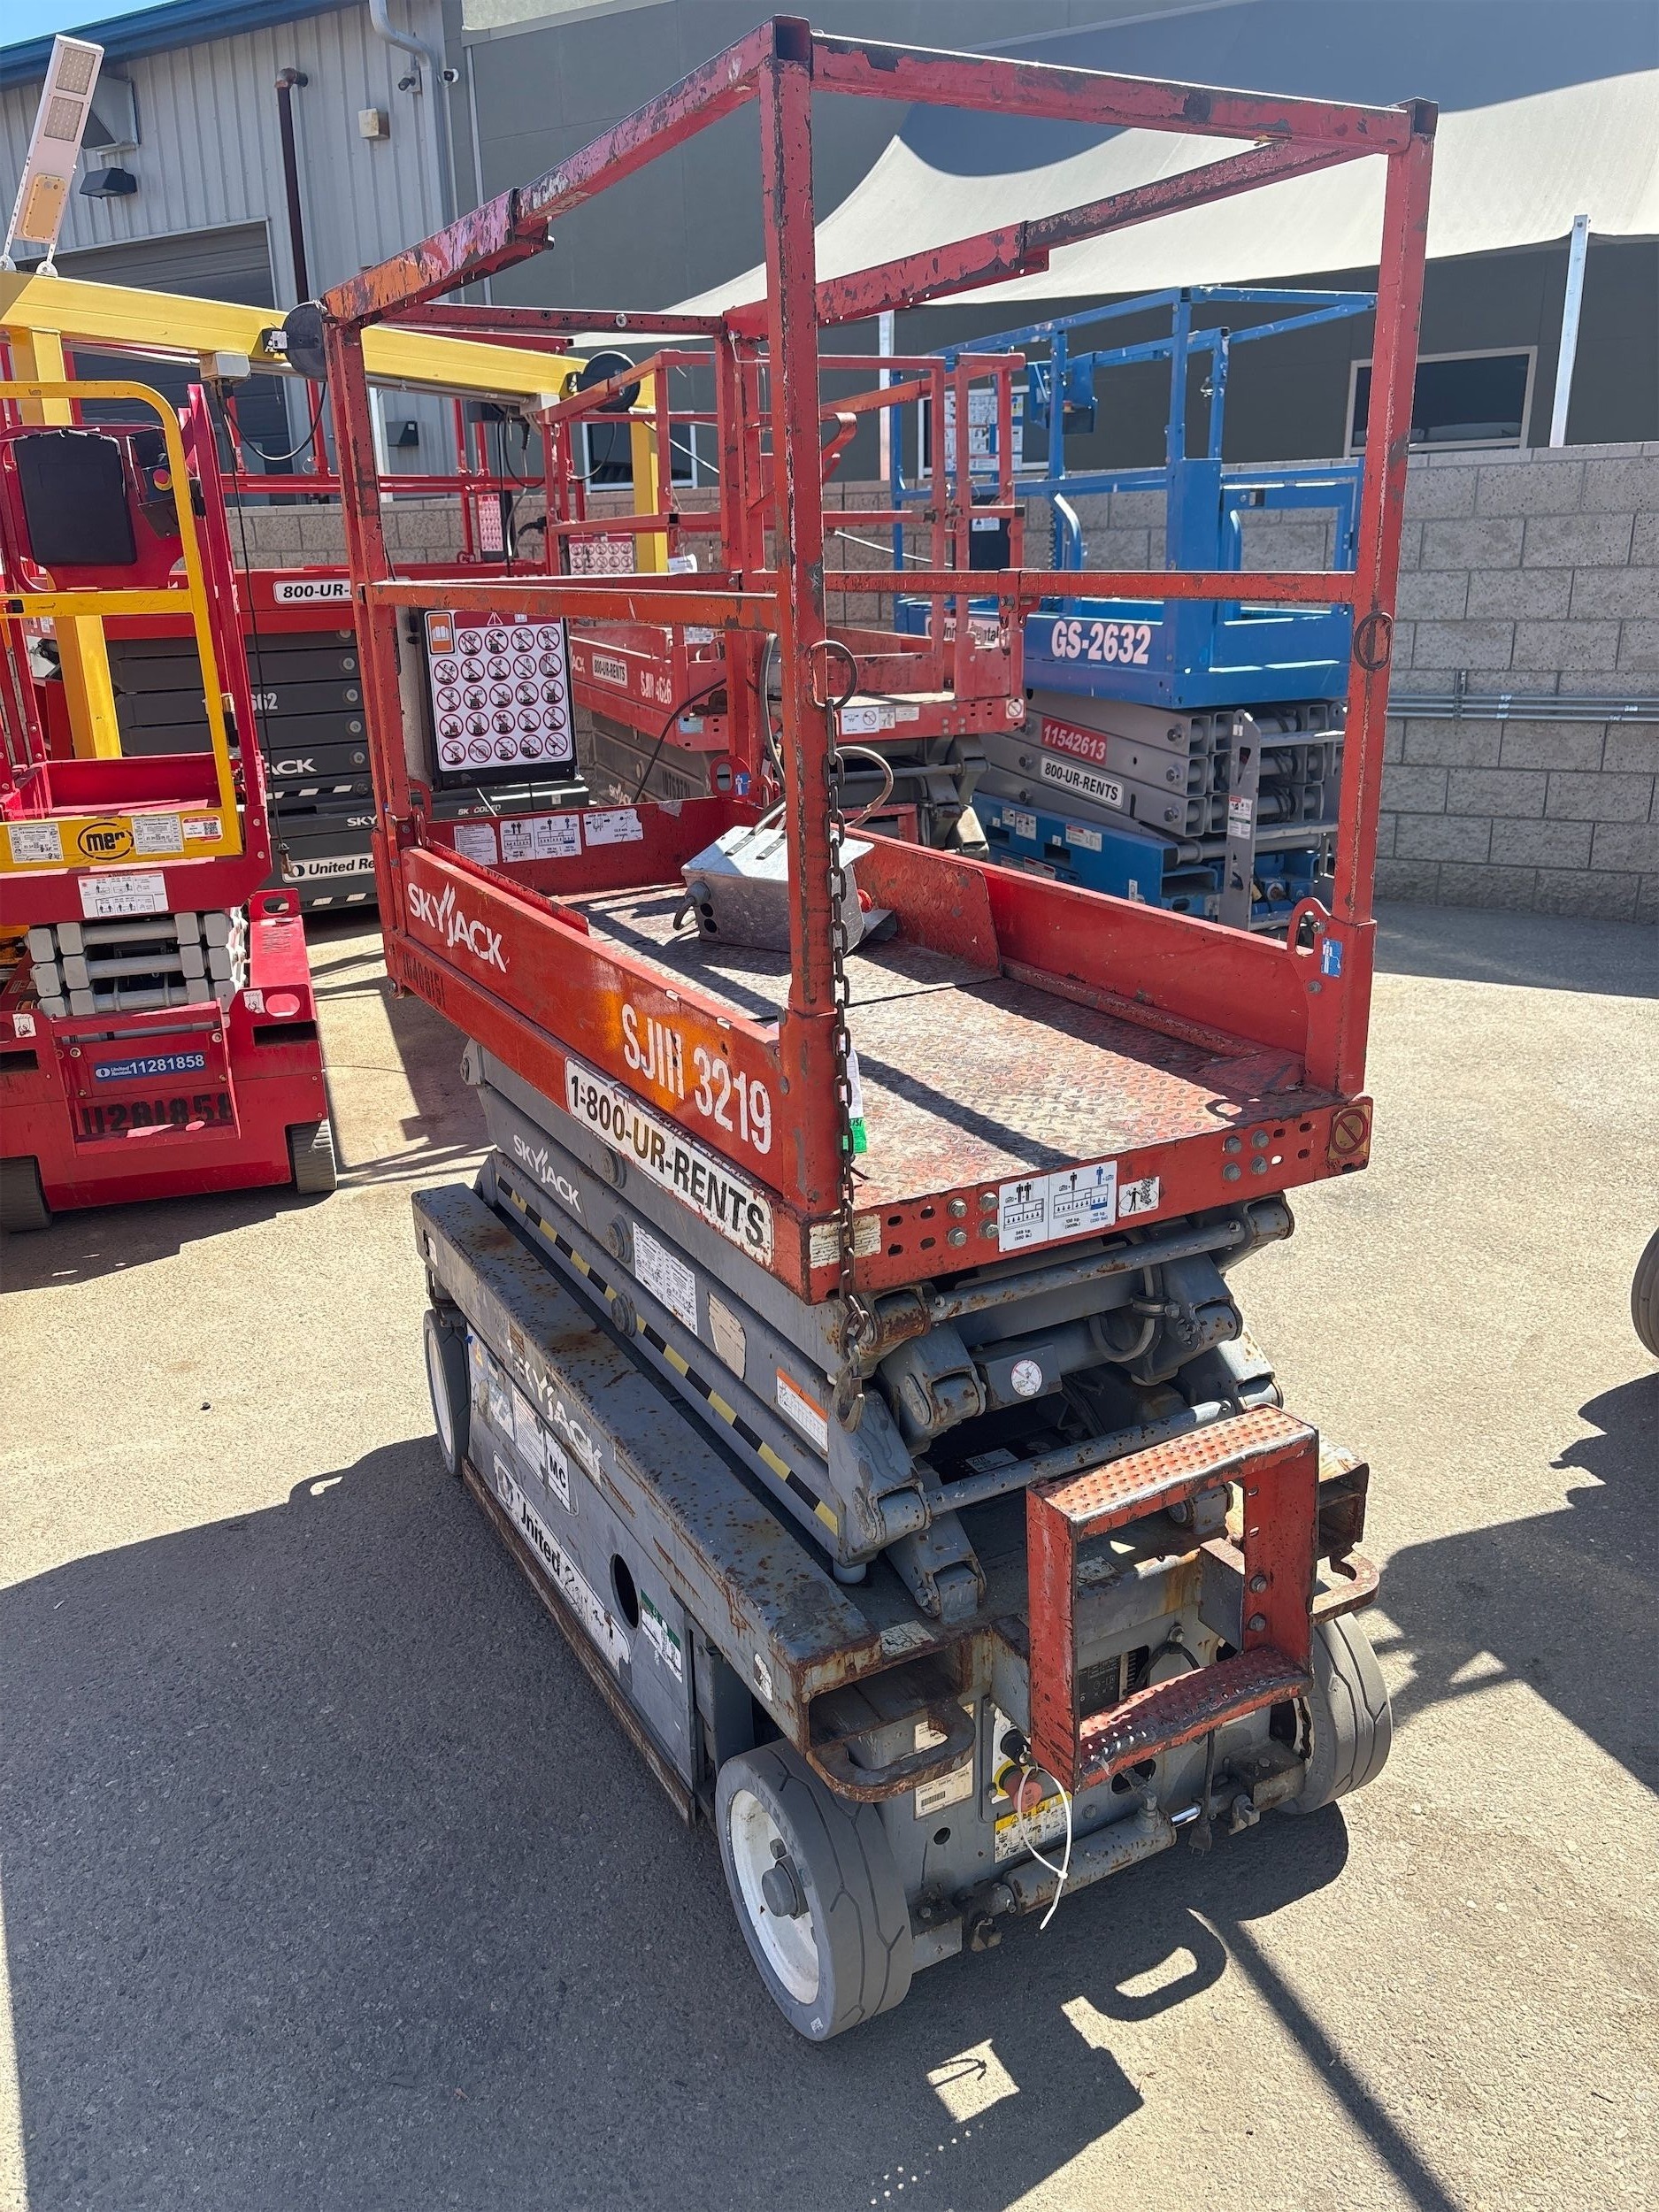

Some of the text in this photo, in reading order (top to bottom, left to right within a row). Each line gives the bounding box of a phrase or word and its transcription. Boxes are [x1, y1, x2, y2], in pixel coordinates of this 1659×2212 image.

[283, 583, 352, 598] 800-UR-
[1051, 620, 1151, 664] GS-2632
[1044, 724, 1107, 760] 11542613
[1044, 762, 1118, 801] 800-UR-RENTS
[309, 859, 355, 875] United
[407, 881, 507, 973] SKYJACK
[130, 1054, 205, 1075] 11281858
[694, 1047, 772, 1155] 3219
[513, 1134, 582, 1213] SKYJACK
[571, 1076, 764, 1248] 1-800-UR-RENTS
[549, 1454, 567, 1490] MC
